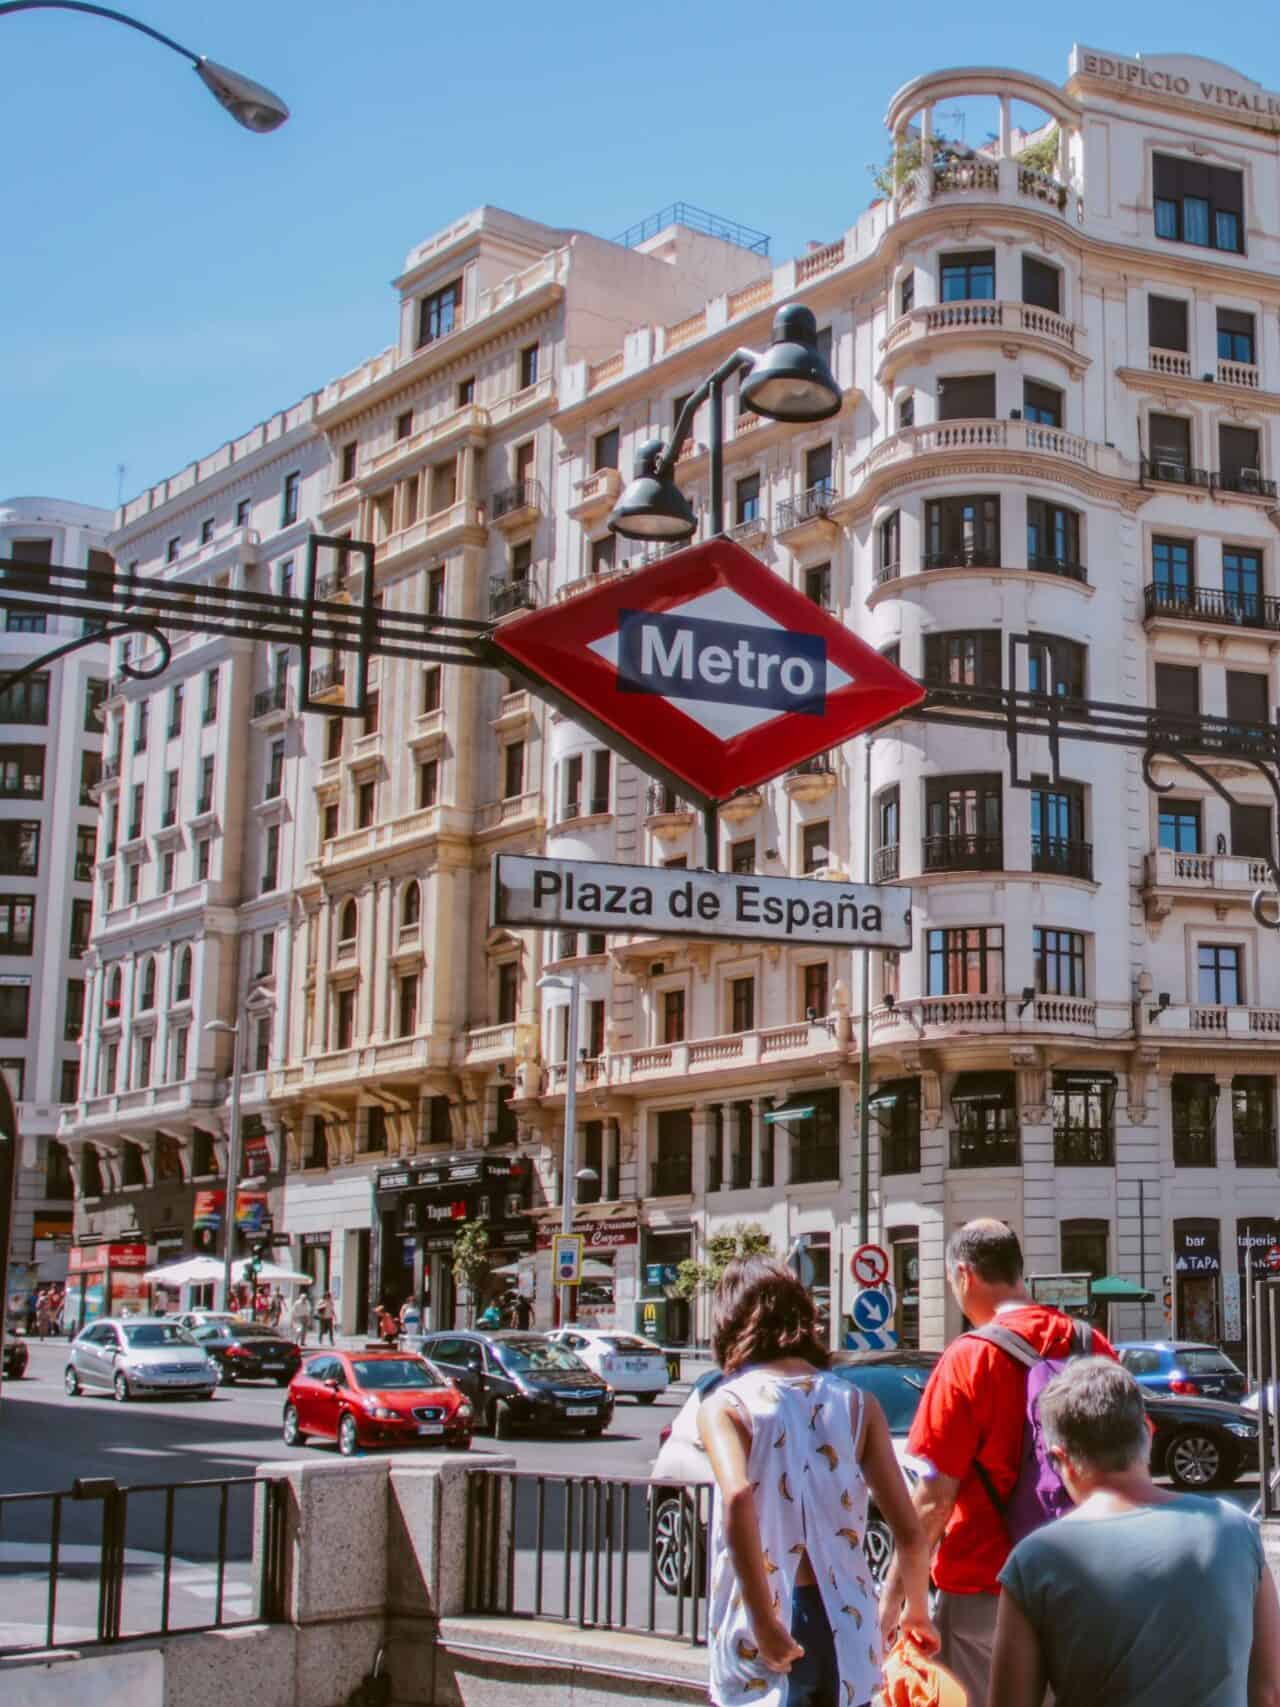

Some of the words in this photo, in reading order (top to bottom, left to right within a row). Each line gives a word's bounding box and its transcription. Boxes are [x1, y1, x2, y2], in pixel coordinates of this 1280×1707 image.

[1083, 54, 1191, 95] EDIFICIO
[640, 624, 815, 696] Metro
[533, 869, 653, 915] Plaza
[668, 881, 721, 919] de
[735, 884, 882, 933] España
[1185, 1235, 1206, 1247] bar
